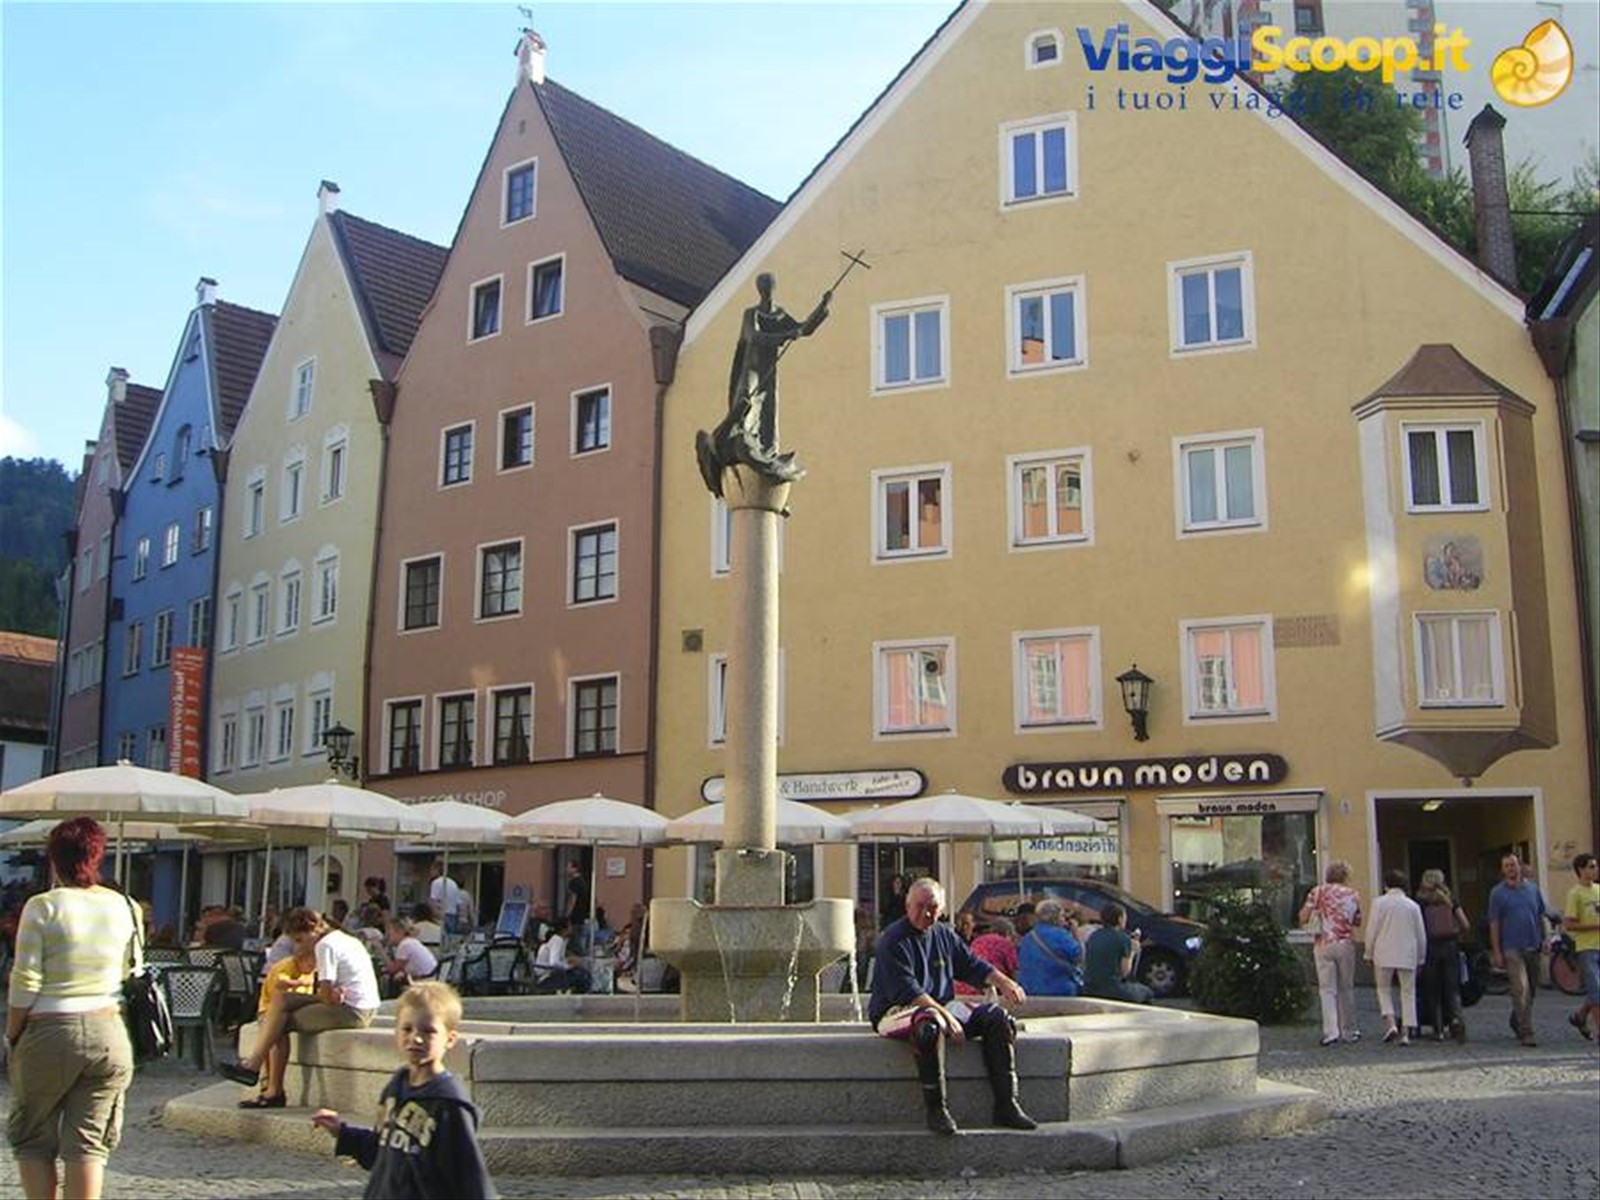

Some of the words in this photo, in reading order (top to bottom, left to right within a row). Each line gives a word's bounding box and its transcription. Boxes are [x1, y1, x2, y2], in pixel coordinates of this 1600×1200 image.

[1017, 766, 1123, 791] braun
[1135, 756, 1270, 786] moden
[793, 779, 858, 794] Handwerk
[1199, 804, 1232, 813] braun
[1237, 801, 1276, 812] moden
